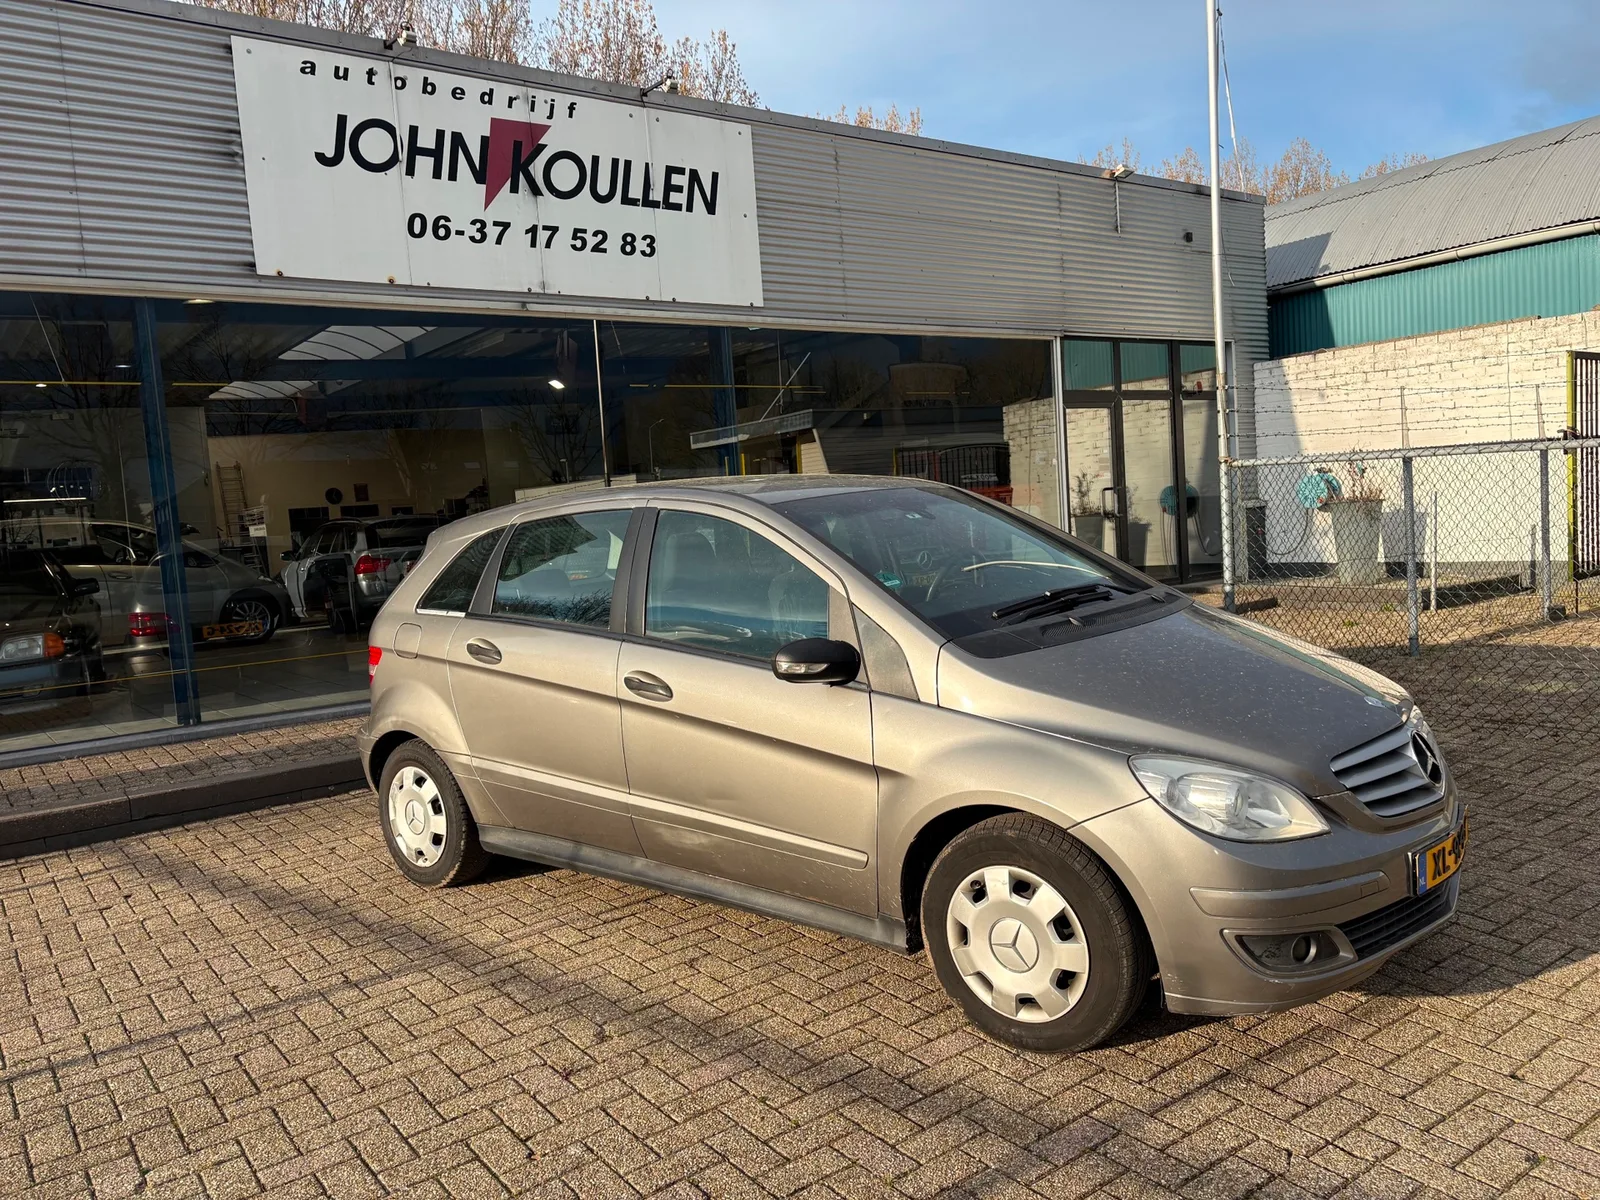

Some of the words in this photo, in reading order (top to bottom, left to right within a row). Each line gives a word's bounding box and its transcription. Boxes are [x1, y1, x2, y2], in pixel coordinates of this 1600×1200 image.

[300, 60, 577, 119] autobedrijf
[314, 113, 488, 185] JOHN
[510, 139, 719, 215] KOULLEN
[407, 212, 510, 245] 06-37
[525, 223, 559, 250] 17
[569, 227, 608, 253] 52
[620, 232, 658, 258] 83
